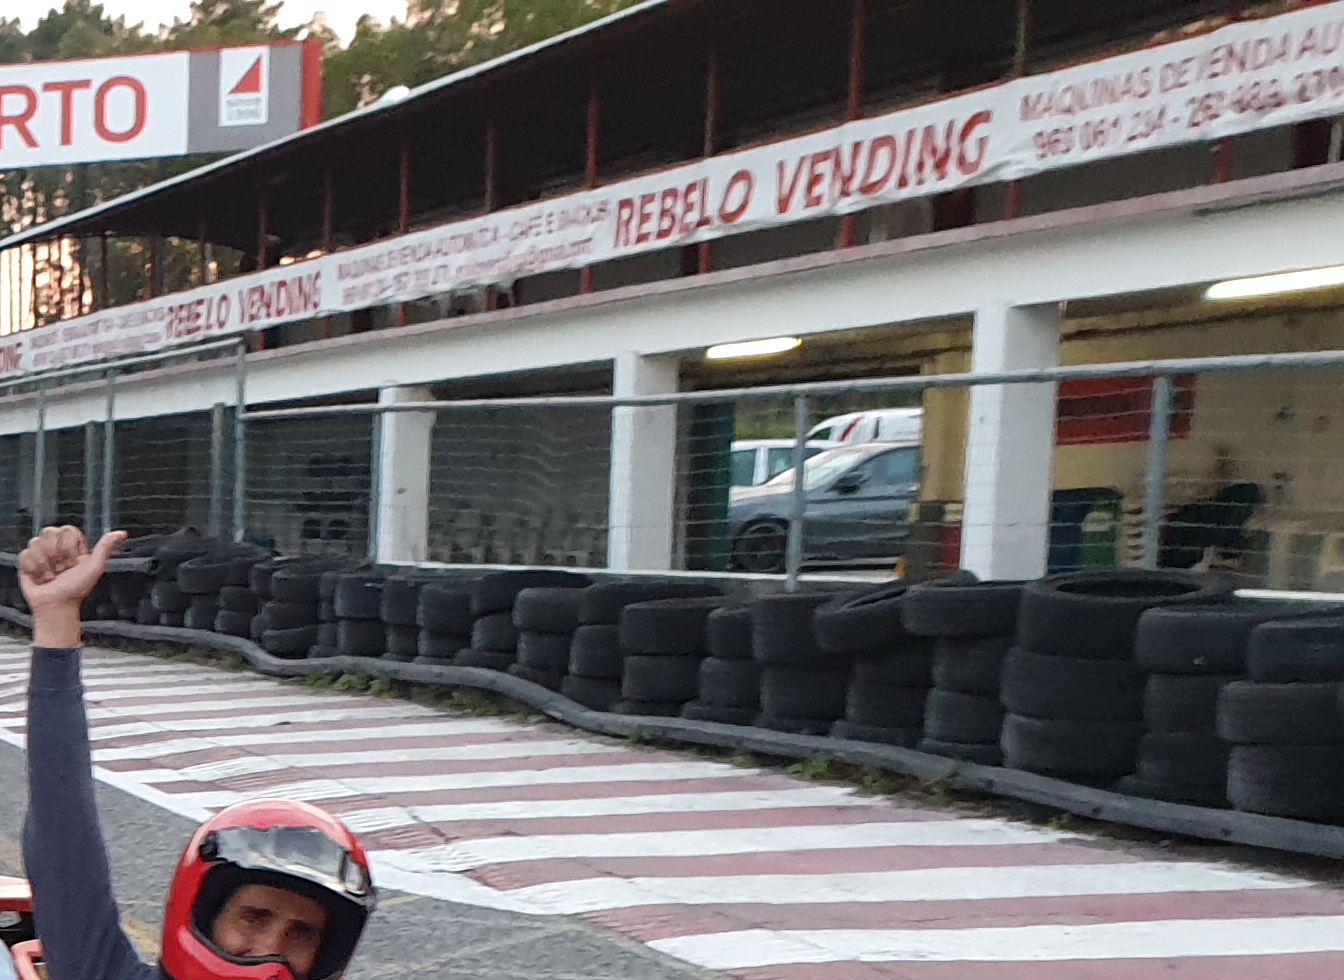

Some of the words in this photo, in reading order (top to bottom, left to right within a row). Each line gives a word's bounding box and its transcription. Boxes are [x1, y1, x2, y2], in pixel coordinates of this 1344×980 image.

[613, 168, 754, 248] REBELO
[776, 109, 994, 216] VENDING
[166, 293, 232, 338] REBELO
[238, 270, 322, 324] VENDING
